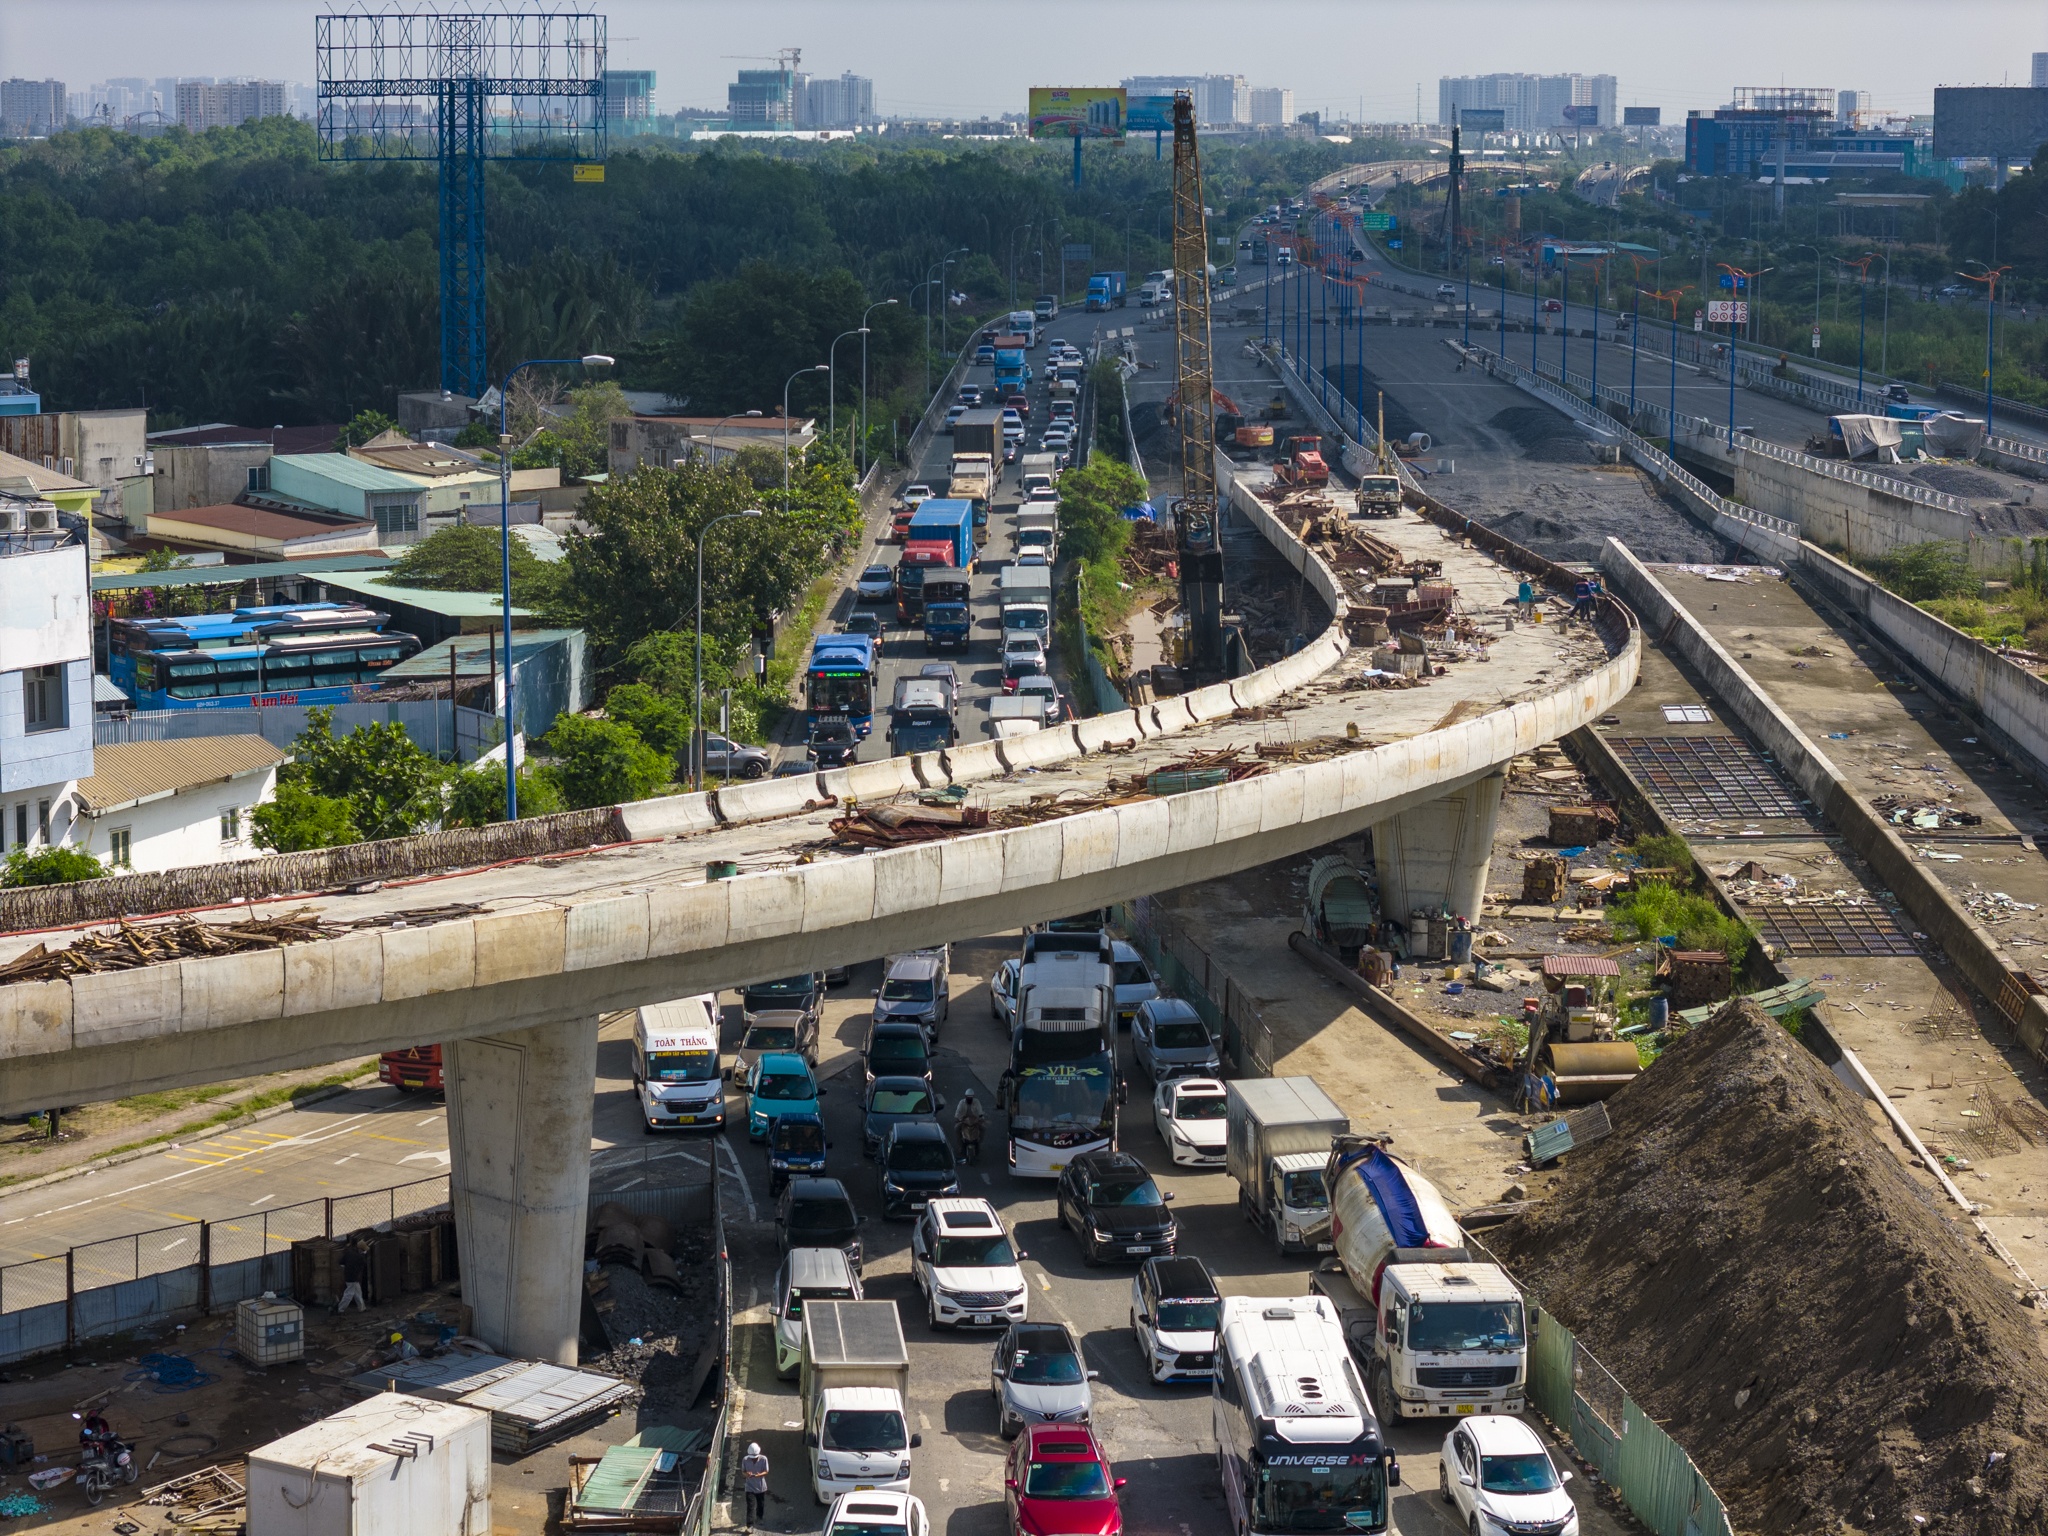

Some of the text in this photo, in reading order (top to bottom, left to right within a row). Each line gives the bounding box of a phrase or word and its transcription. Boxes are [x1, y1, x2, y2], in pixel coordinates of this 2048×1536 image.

[655, 1037, 676, 1047] TOÀN
[1048, 1065, 1076, 1076] VIP
[1267, 1455, 1349, 1466] UNIVERSE
[1351, 1454, 1366, 1465] X
